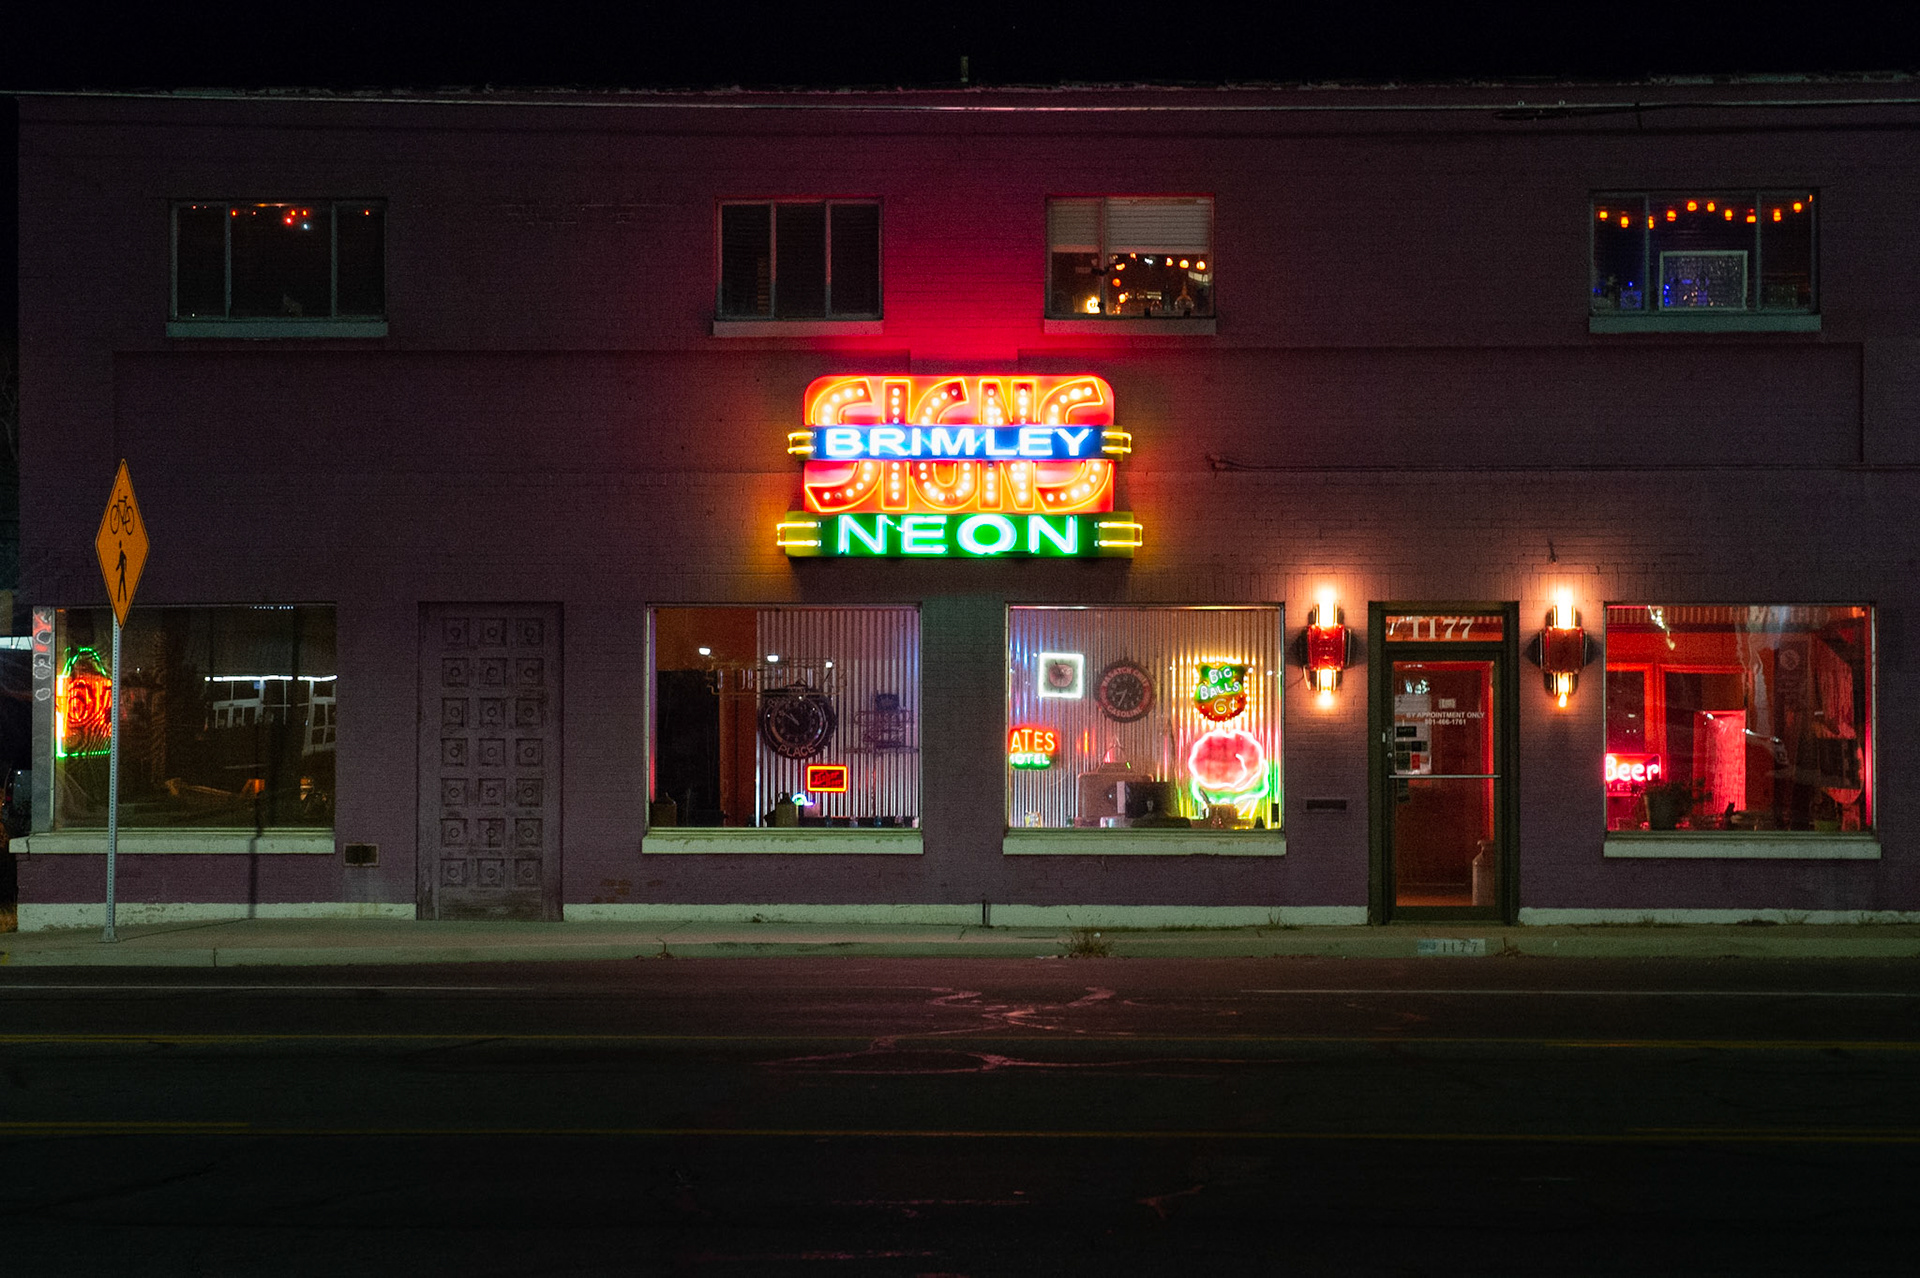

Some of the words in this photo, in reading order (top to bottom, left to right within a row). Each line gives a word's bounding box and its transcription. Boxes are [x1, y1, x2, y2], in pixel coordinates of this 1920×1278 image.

[805, 378, 1111, 513] SIGNS
[825, 428, 1094, 457] BRIMLEY
[837, 514, 1079, 555] NEON
[1412, 618, 1475, 639] 1177
[1208, 667, 1233, 684] BIG
[1200, 681, 1240, 700] BALLS
[1106, 705, 1143, 718] GASOLINE
[777, 743, 816, 757] PLACE
[1010, 729, 1056, 752] ATES
[1605, 754, 1660, 782] Beer
[1443, 941, 1478, 953] 1177
